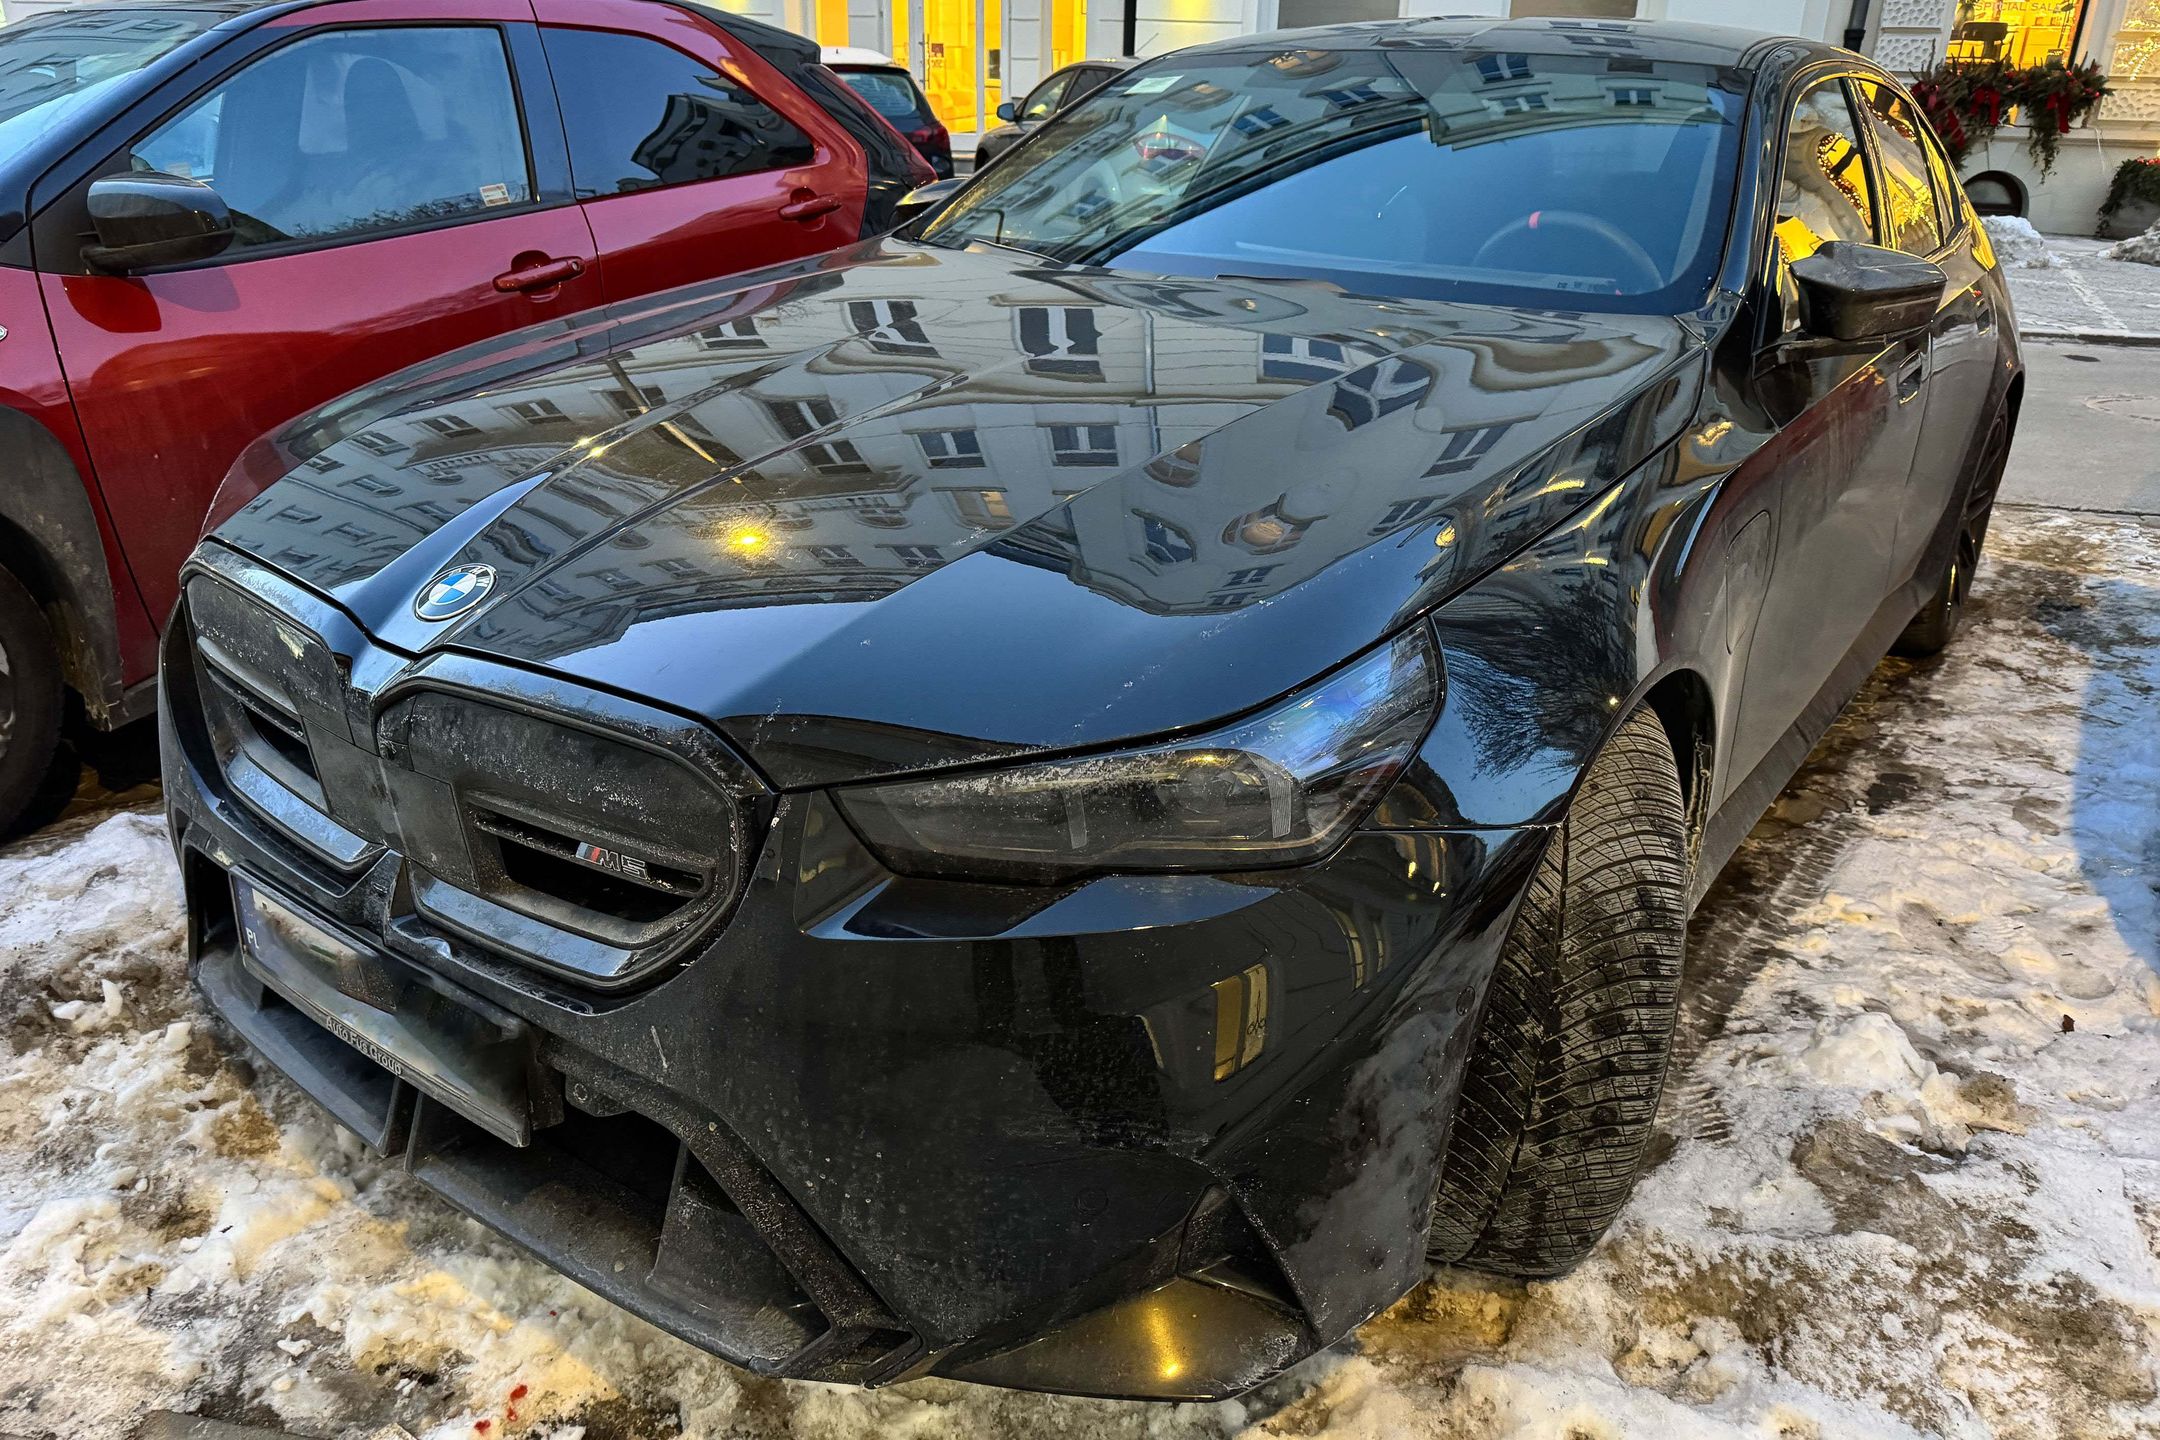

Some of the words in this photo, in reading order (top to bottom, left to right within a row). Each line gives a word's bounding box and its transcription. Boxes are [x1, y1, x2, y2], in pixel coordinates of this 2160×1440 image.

[1975, 2, 2027, 12] SPCIAL
[448, 565, 492, 588] BMW
[597, 847, 648, 880] M5
[245, 927, 259, 949] PL
[326, 1016, 348, 1042] Auto
[349, 1031, 368, 1055] Fus
[369, 1044, 402, 1075] Group
